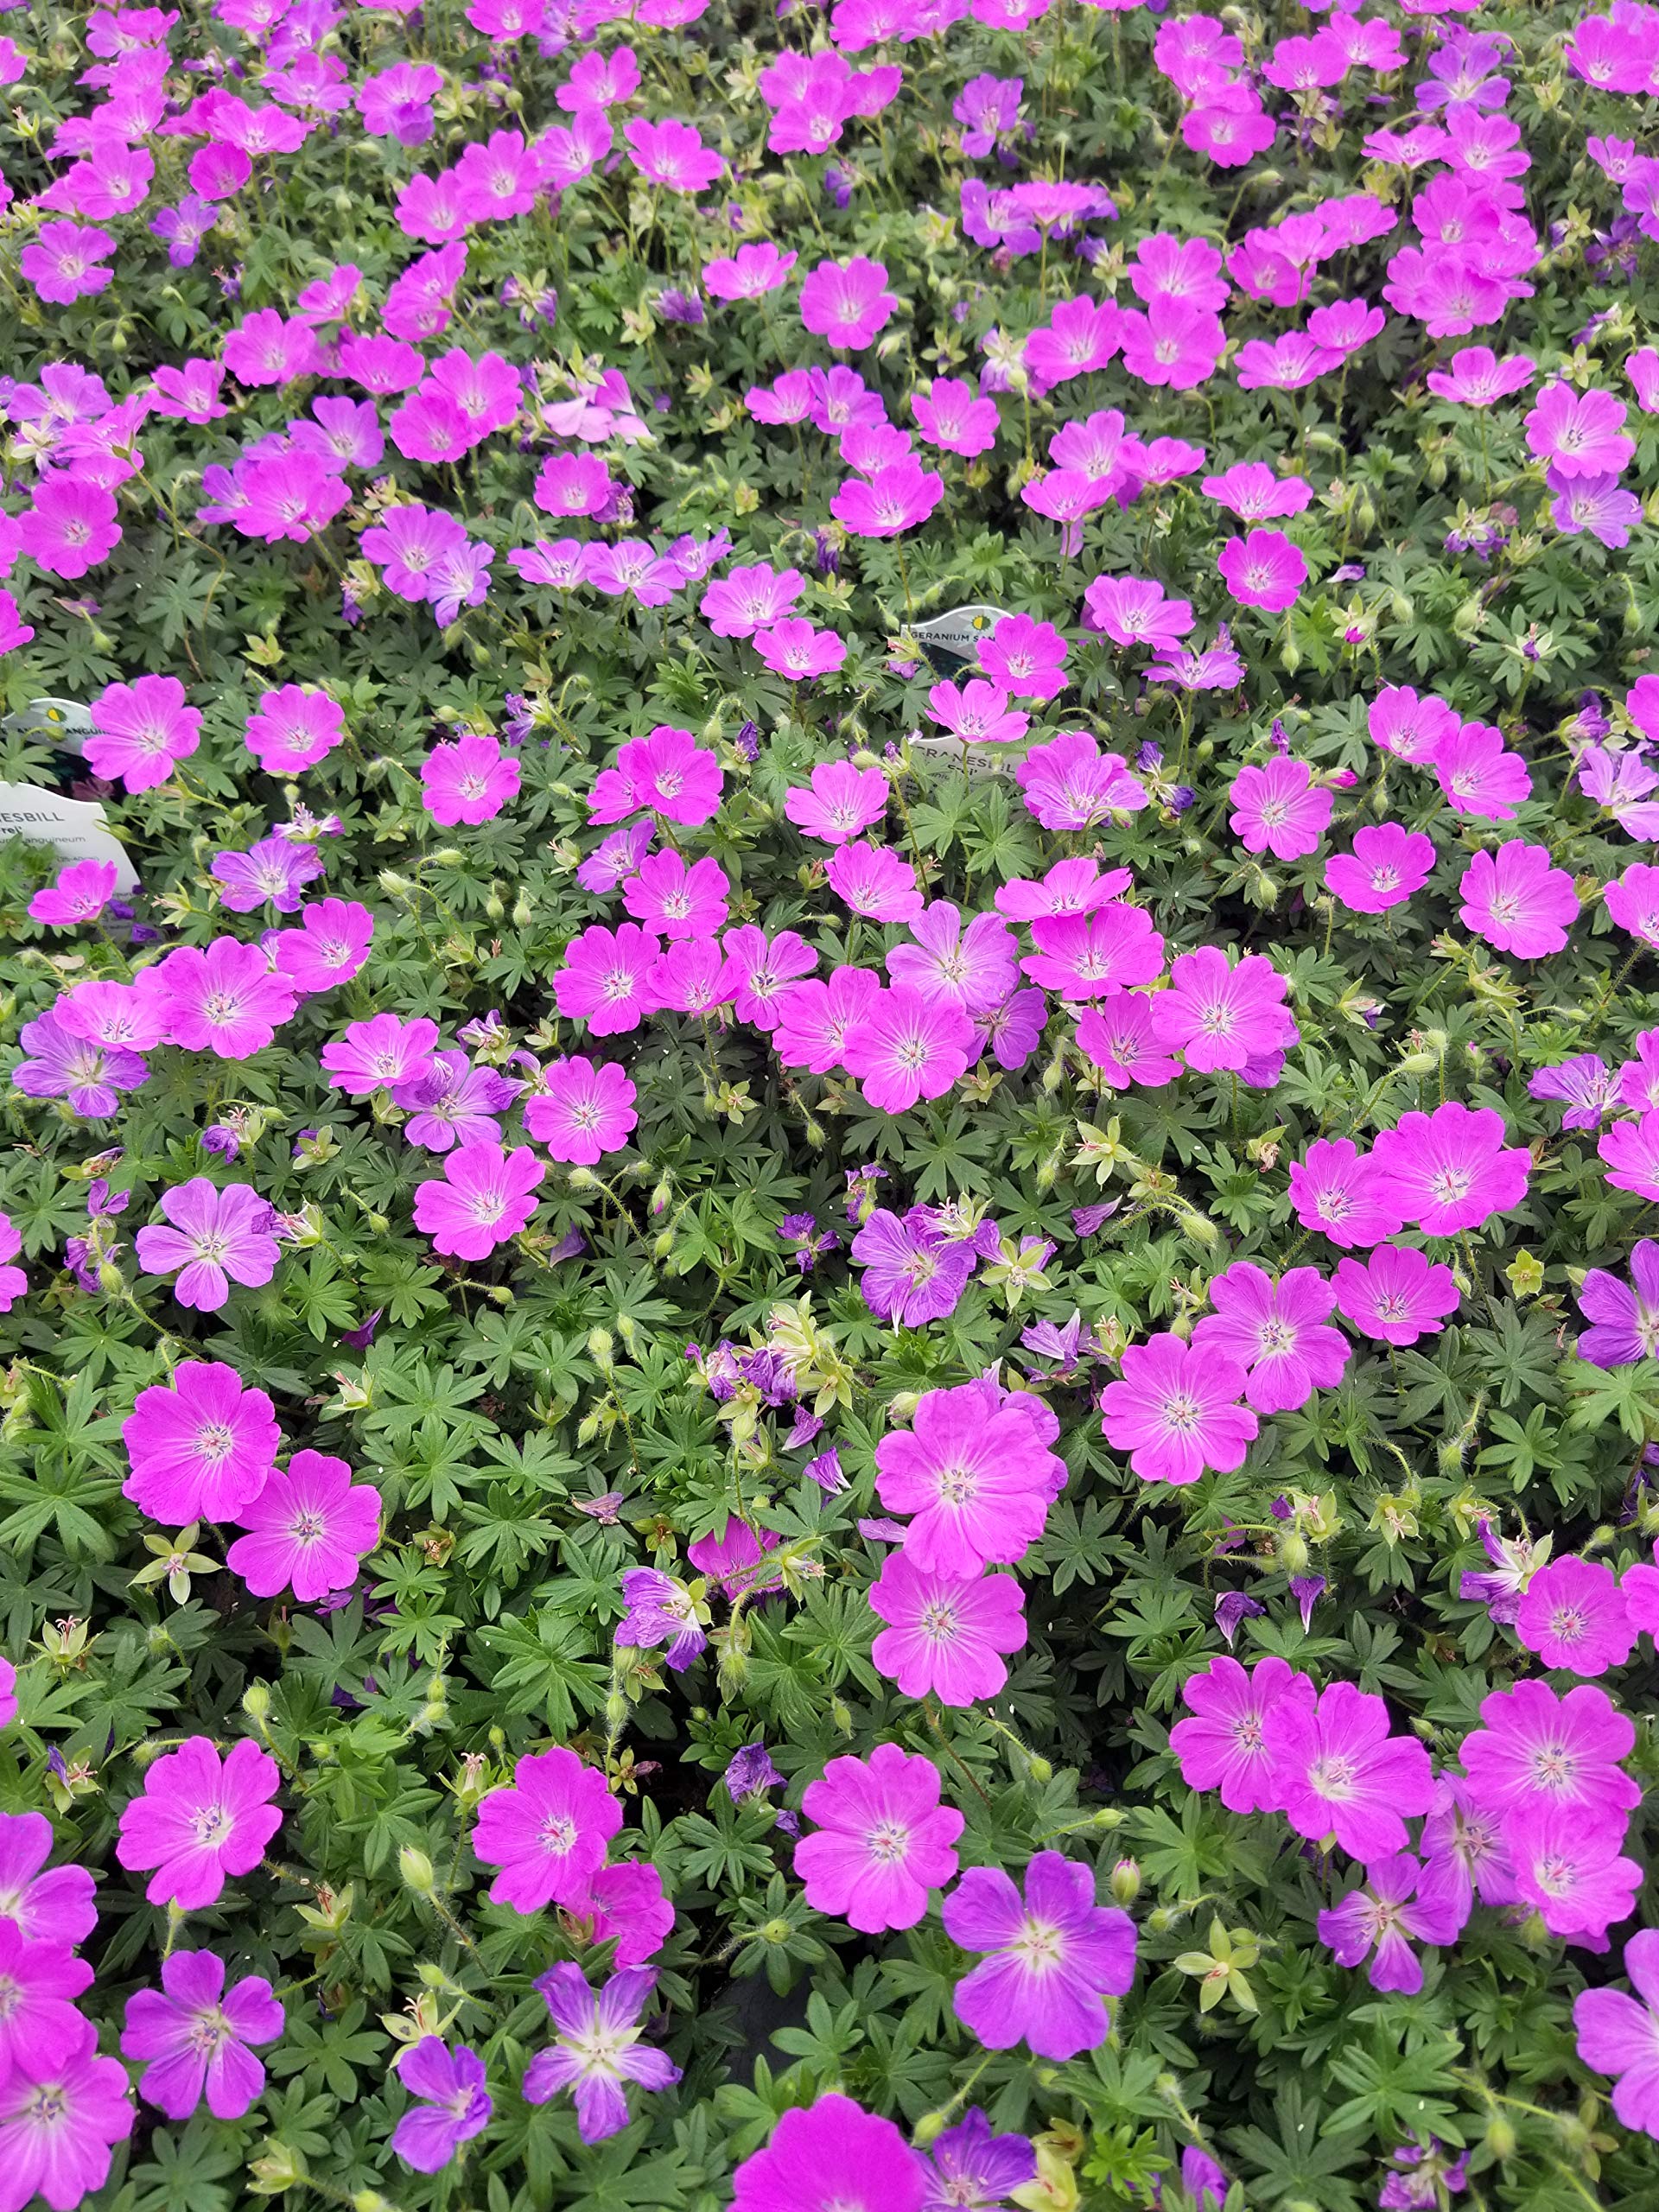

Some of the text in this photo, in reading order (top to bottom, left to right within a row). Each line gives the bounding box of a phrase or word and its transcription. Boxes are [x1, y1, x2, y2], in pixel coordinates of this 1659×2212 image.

[911, 631, 969, 642] GERANIUM
[0, 811, 65, 823] ESBILL
[0, 825, 22, 835] rei'
[24, 836, 86, 845] anguineum
